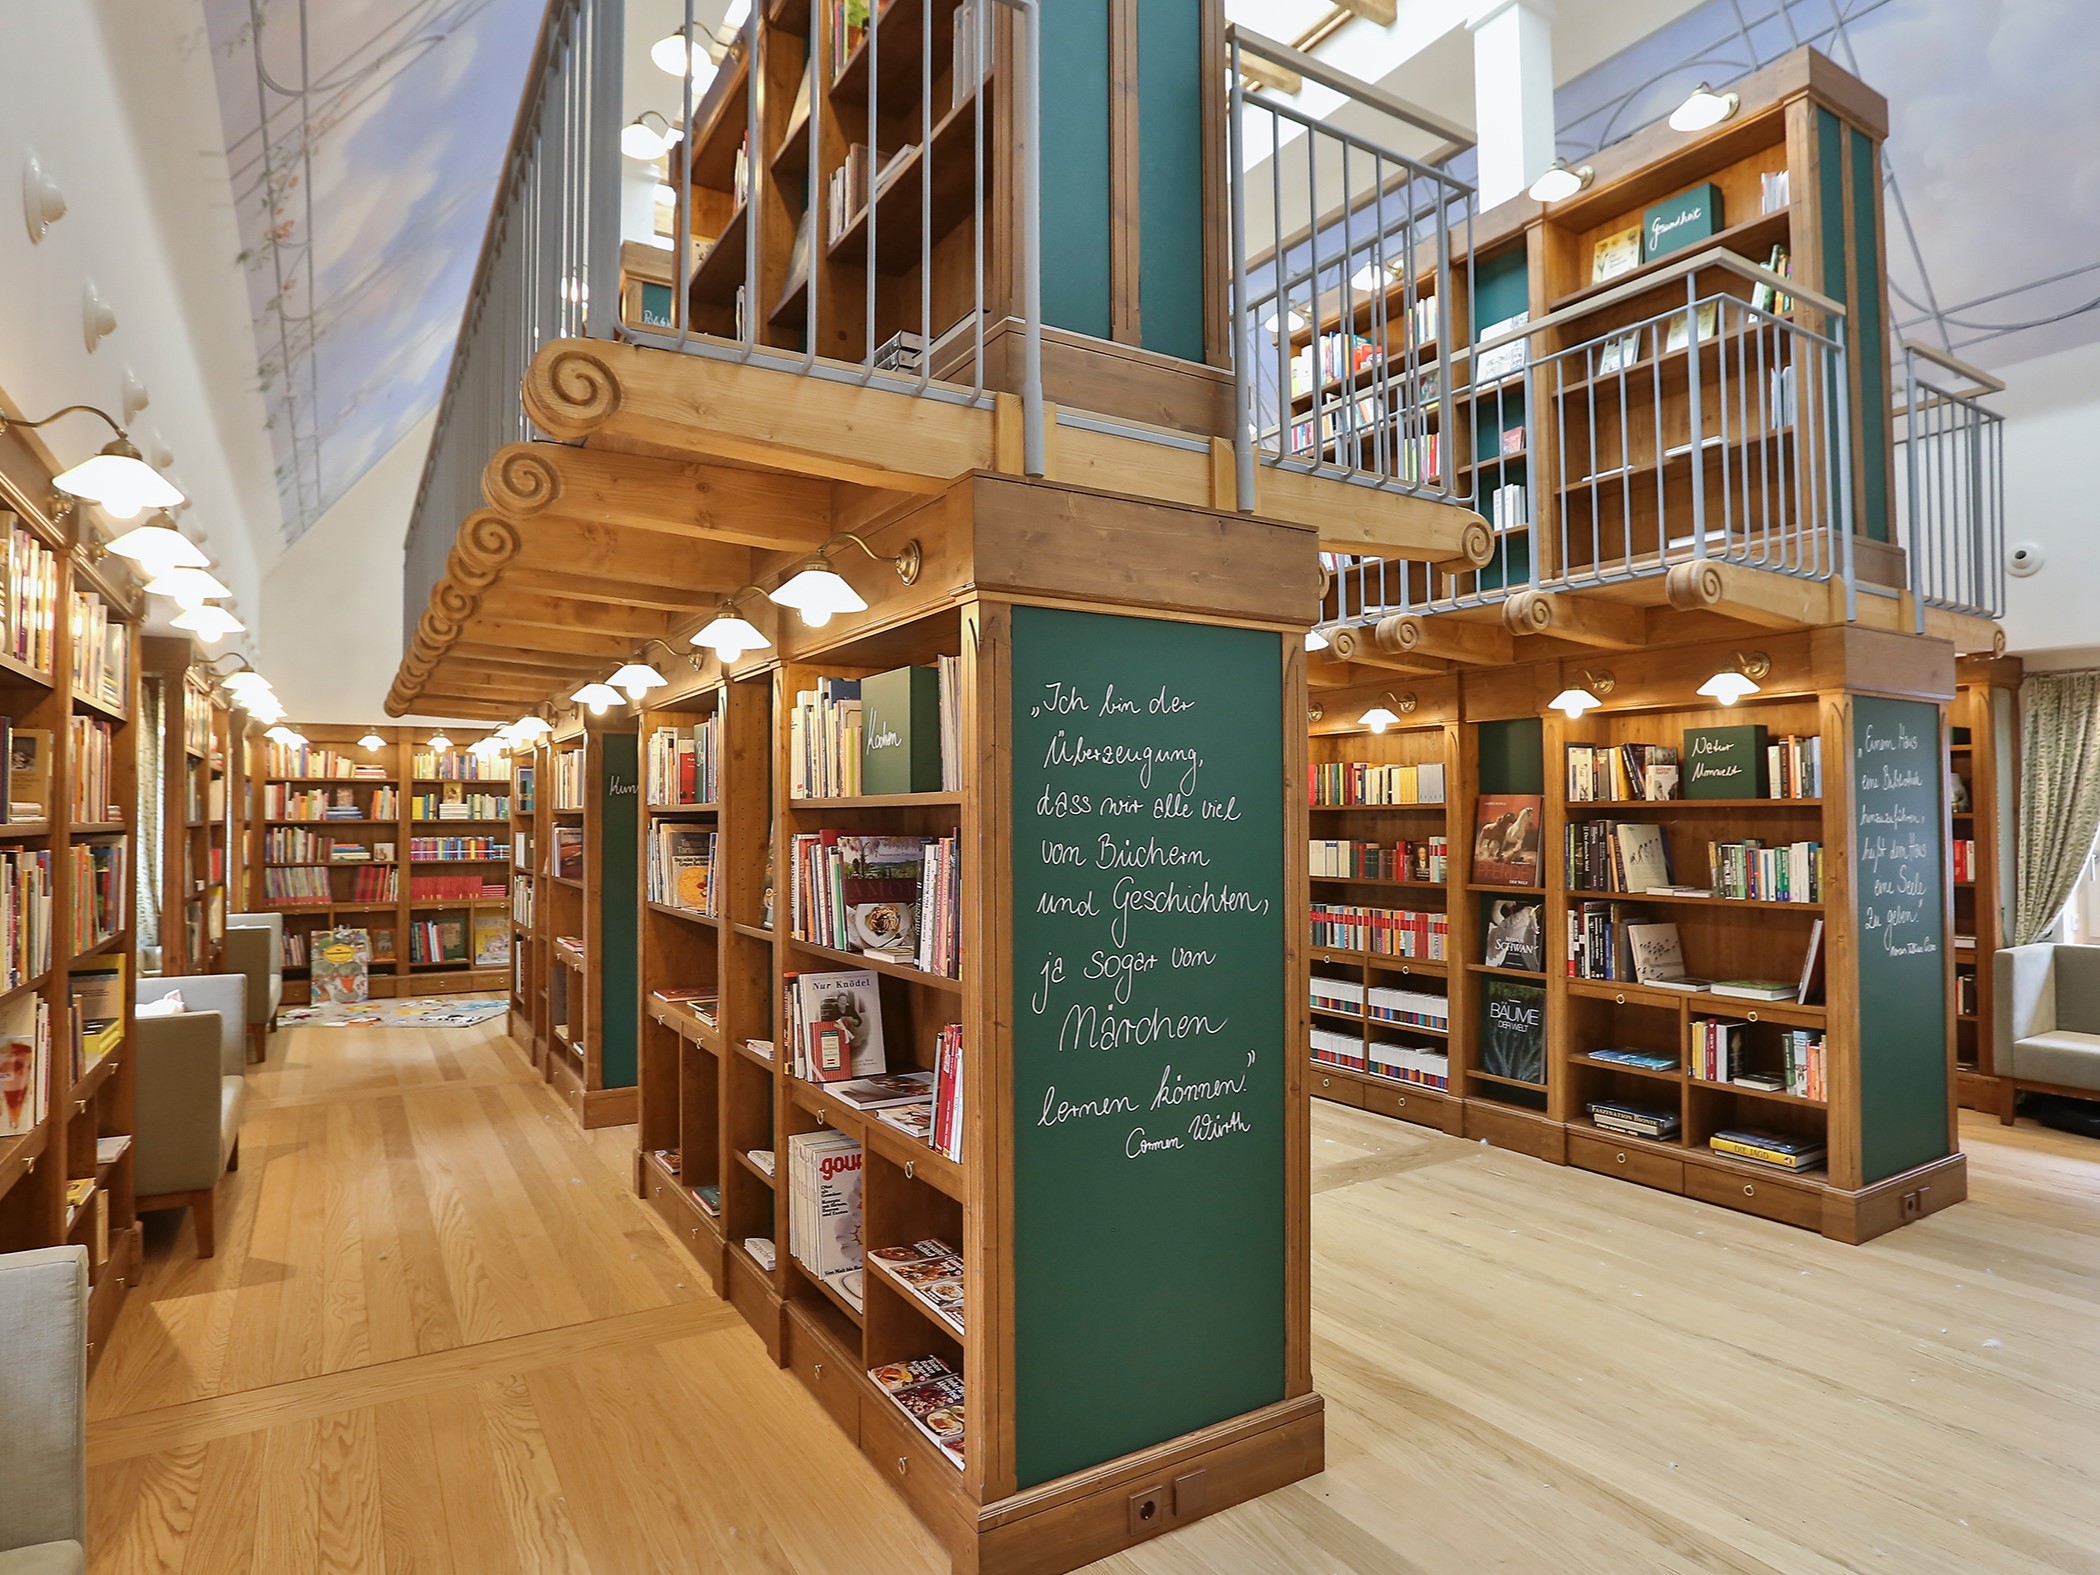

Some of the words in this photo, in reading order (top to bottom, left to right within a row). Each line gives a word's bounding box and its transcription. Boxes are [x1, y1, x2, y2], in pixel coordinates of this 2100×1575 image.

[1649, 207, 1702, 252] Gesundheit
[1098, 683, 1142, 718] bin
[1149, 685, 1195, 715] der
[866, 706, 902, 755] Kochen
[1898, 722, 1918, 750] Haus
[1691, 736, 1735, 757] Natur
[1042, 729, 1204, 797] Überzeugung,
[1691, 762, 1743, 782] Umwelt
[1862, 769, 1880, 791] eine
[1883, 765, 1923, 791] Bibliothek
[1036, 784, 1092, 818] dass
[1100, 794, 1144, 816] wir
[1152, 792, 1195, 818] alle
[1201, 796, 1242, 821] viel
[1041, 839, 1087, 865] von
[1095, 832, 1211, 869] Büchern
[1908, 832, 1927, 861] Haus
[1477, 861, 1529, 880] PFERDE
[1874, 879, 1895, 897] eine
[1897, 863, 1928, 896] Seele
[1036, 890, 1100, 916] und
[1111, 876, 1269, 948] Geschichten,
[1494, 938, 1534, 954] SCHWAN
[812, 981, 832, 991] Nur
[836, 978, 870, 989] Knödel
[1032, 951, 1066, 1015] ja
[1084, 950, 1159, 1004] sogar
[1171, 947, 1217, 969] von
[1058, 1003, 1230, 1051] Märchen
[1490, 1001, 1540, 1026] BÄUME
[1497, 1019, 1511, 1030] DER
[1510, 1021, 1529, 1033] WELT
[1037, 1085, 1140, 1126] lernen
[1591, 1105, 1633, 1121] FASZINATION
[1733, 1144, 1747, 1155] DIE
[1749, 1150, 1769, 1160] JAGD
